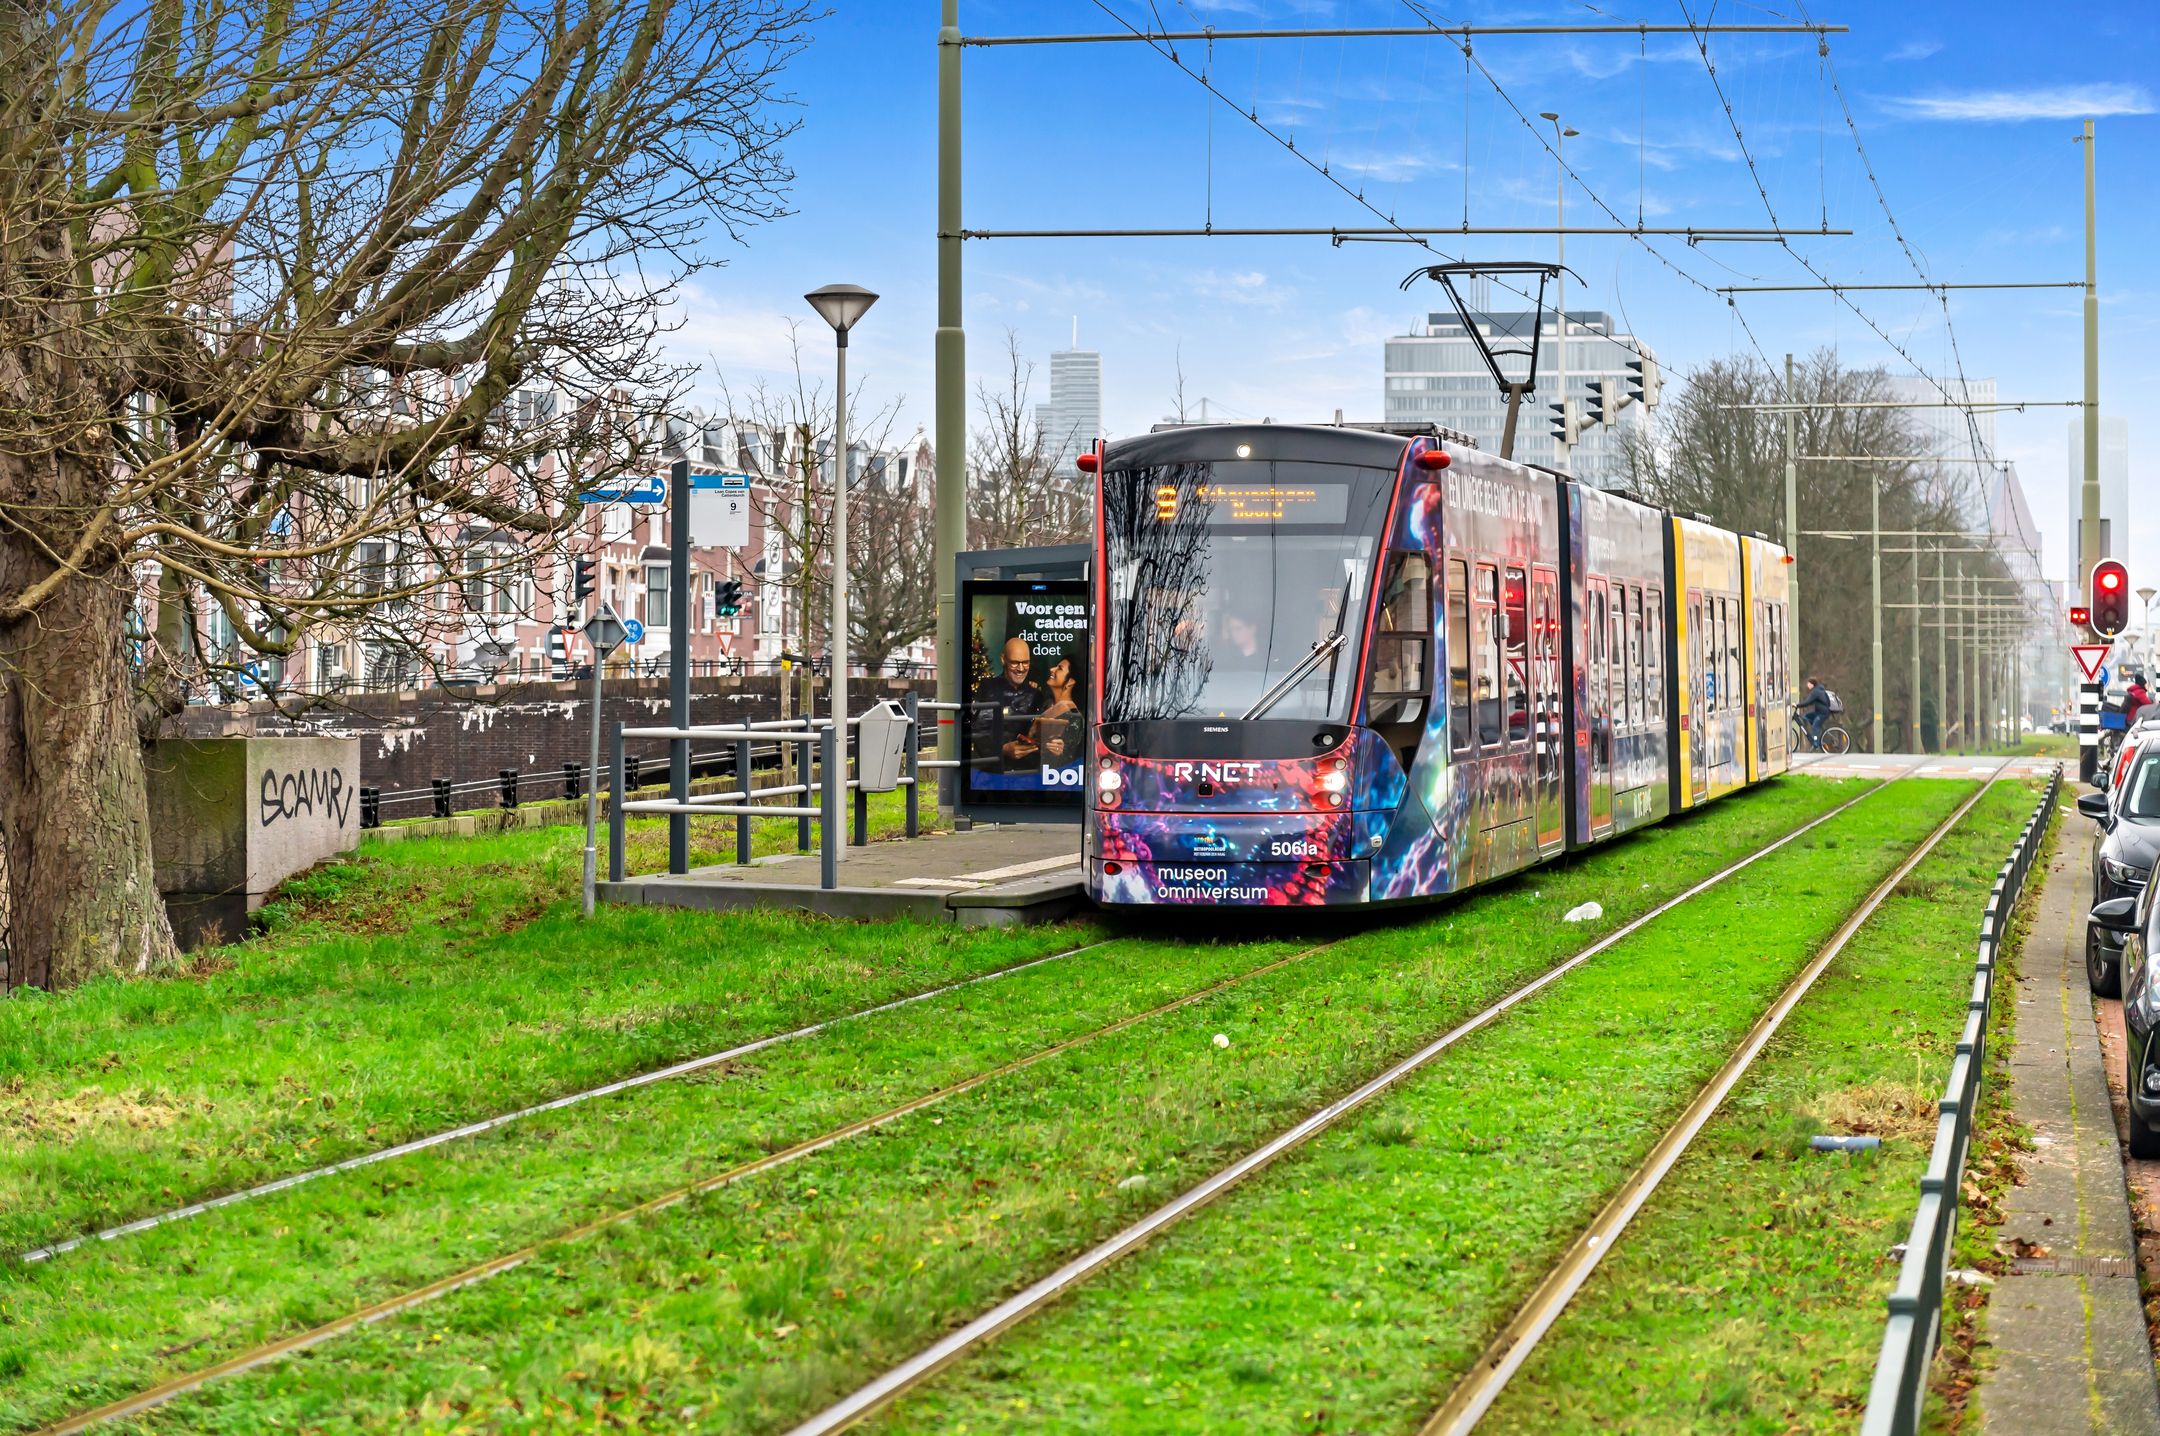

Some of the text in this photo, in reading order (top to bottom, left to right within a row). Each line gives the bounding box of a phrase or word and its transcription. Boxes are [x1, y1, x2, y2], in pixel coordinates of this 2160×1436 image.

[730, 502, 737, 511] 9
[1015, 602, 1085, 615] Voor een
[1019, 629, 1073, 642] dat ertoe
[1032, 643, 1061, 656] doet
[1042, 764, 1084, 786] bol
[1271, 841, 1318, 856] 5061a
[1158, 867, 1227, 880] museon
[1158, 883, 1269, 899] omniversum
